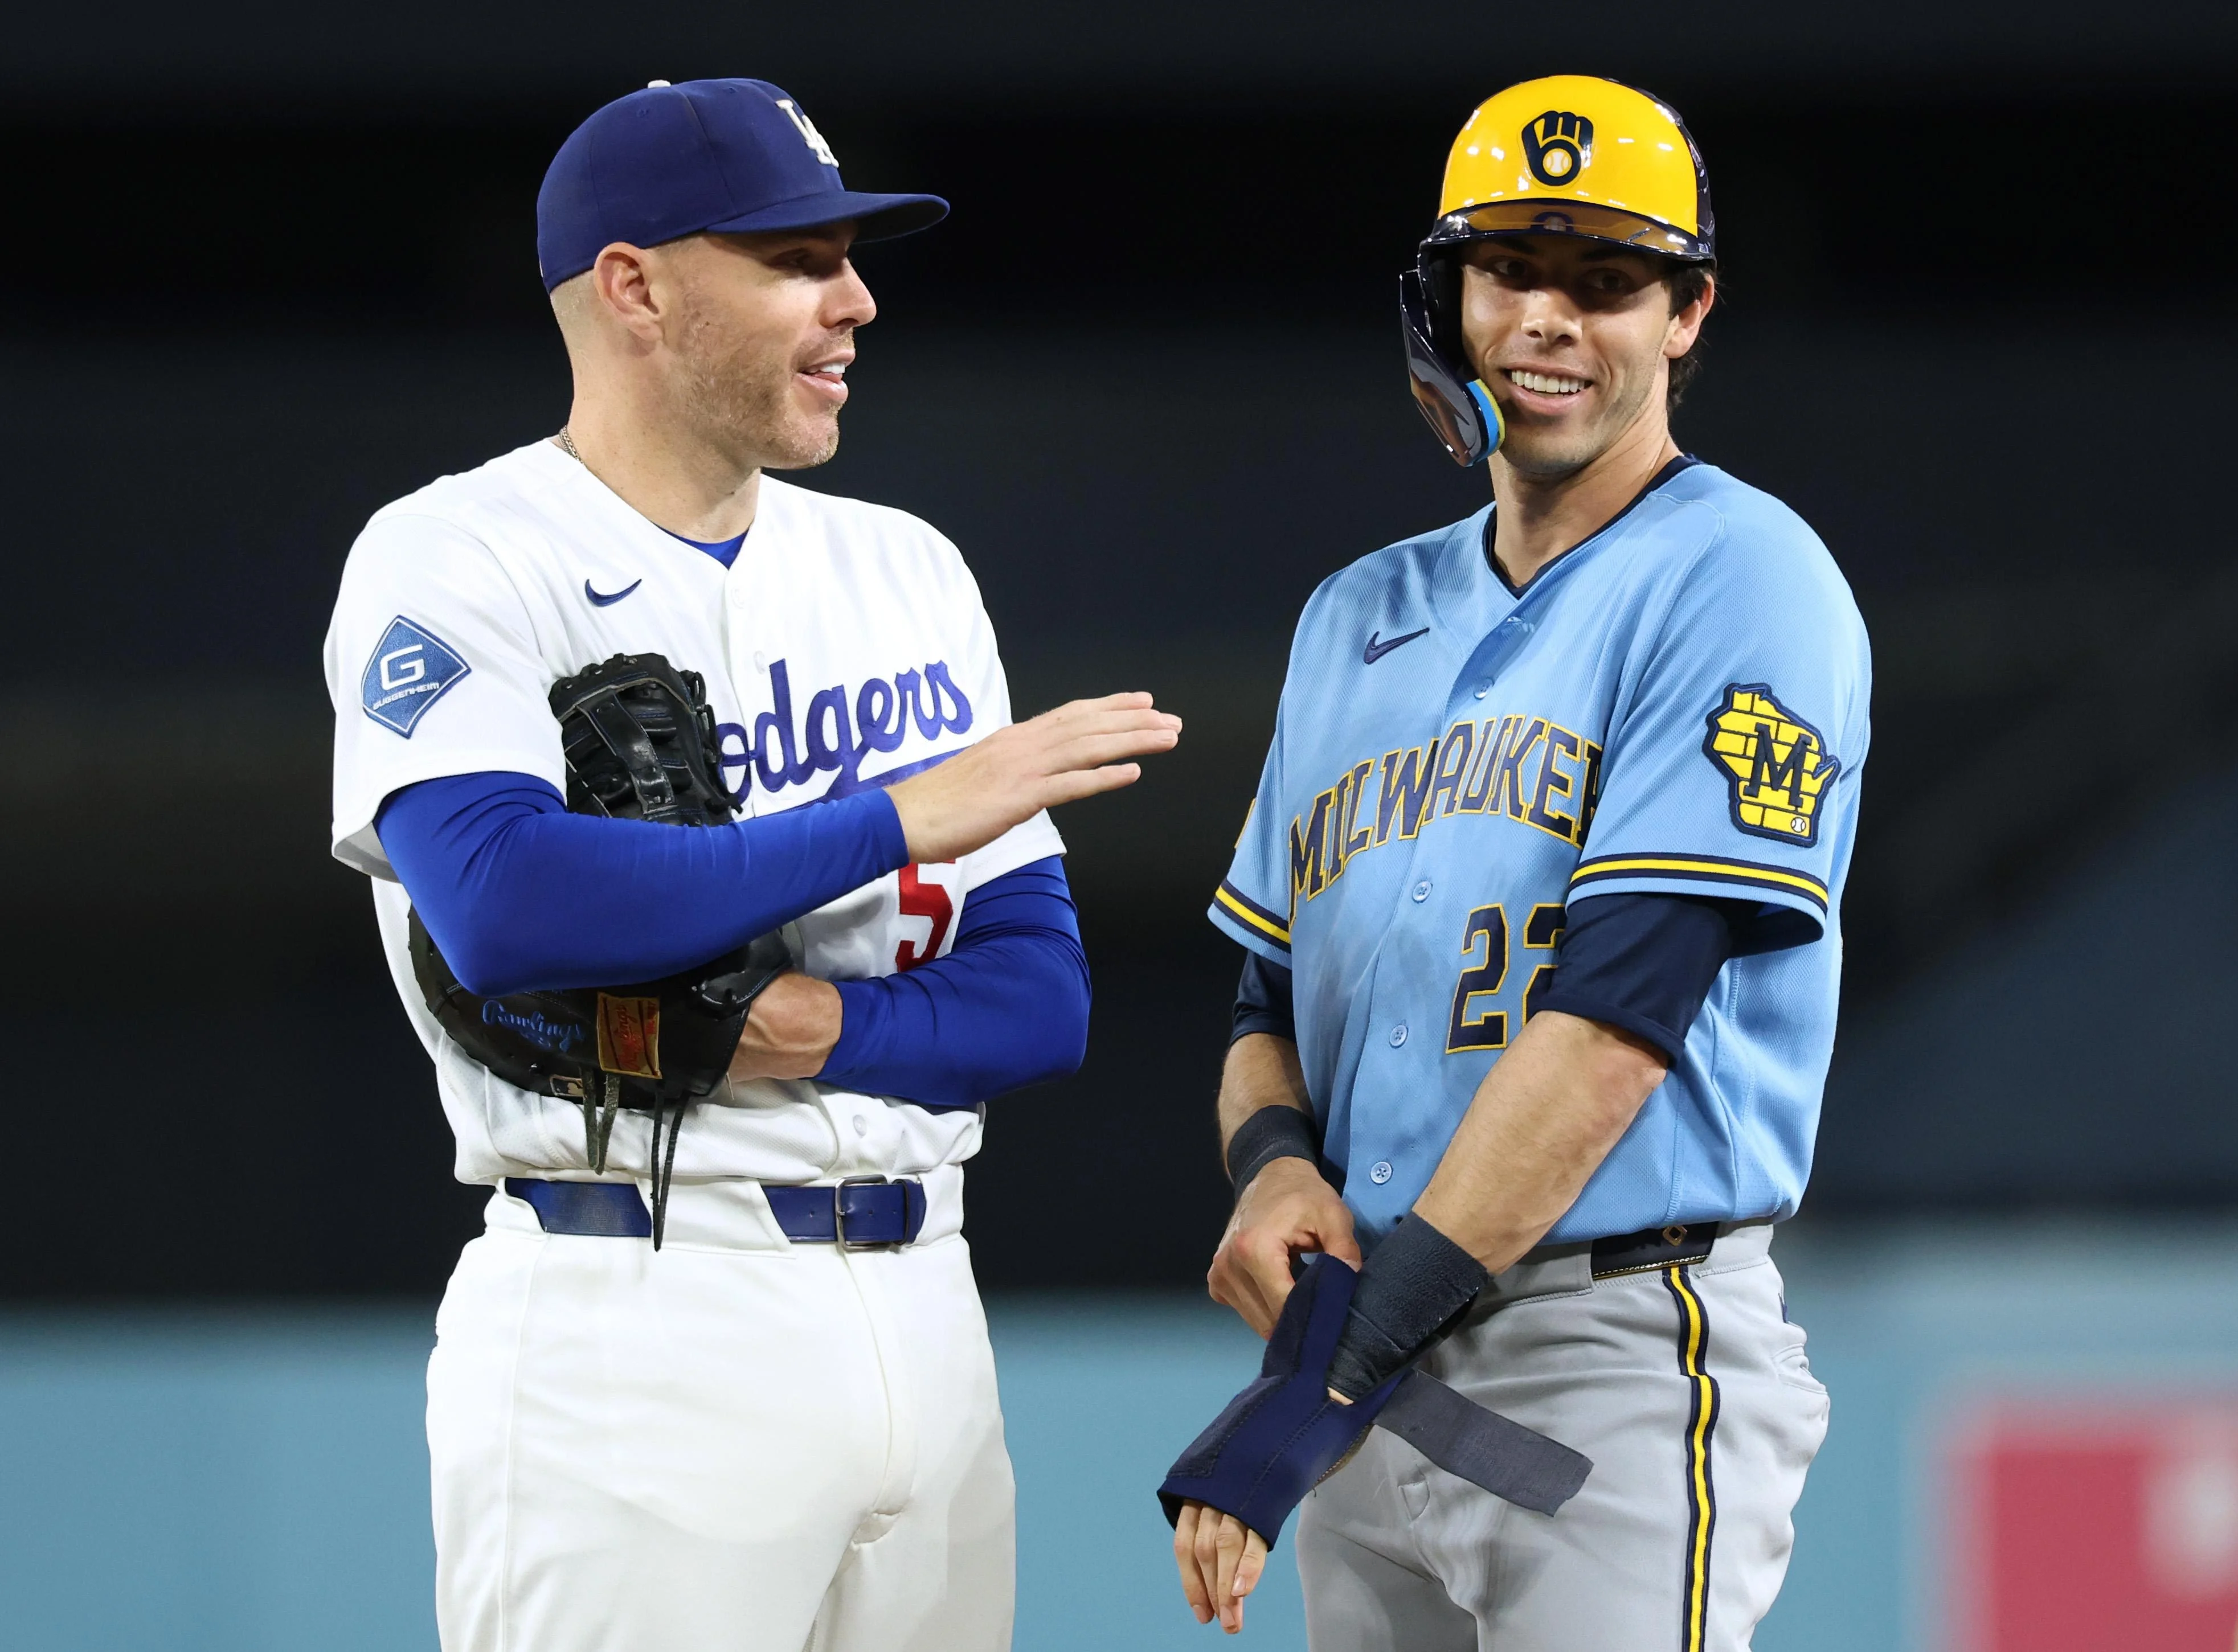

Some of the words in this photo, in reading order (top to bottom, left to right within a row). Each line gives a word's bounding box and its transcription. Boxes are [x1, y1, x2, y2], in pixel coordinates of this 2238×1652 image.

[775, 99, 840, 168] LA
[372, 682, 439, 711] GUGGENHEIM
[380, 644, 425, 691] G
[717, 658, 973, 805] odgers
[1743, 722, 1813, 809] M
[895, 856, 956, 973] 5
